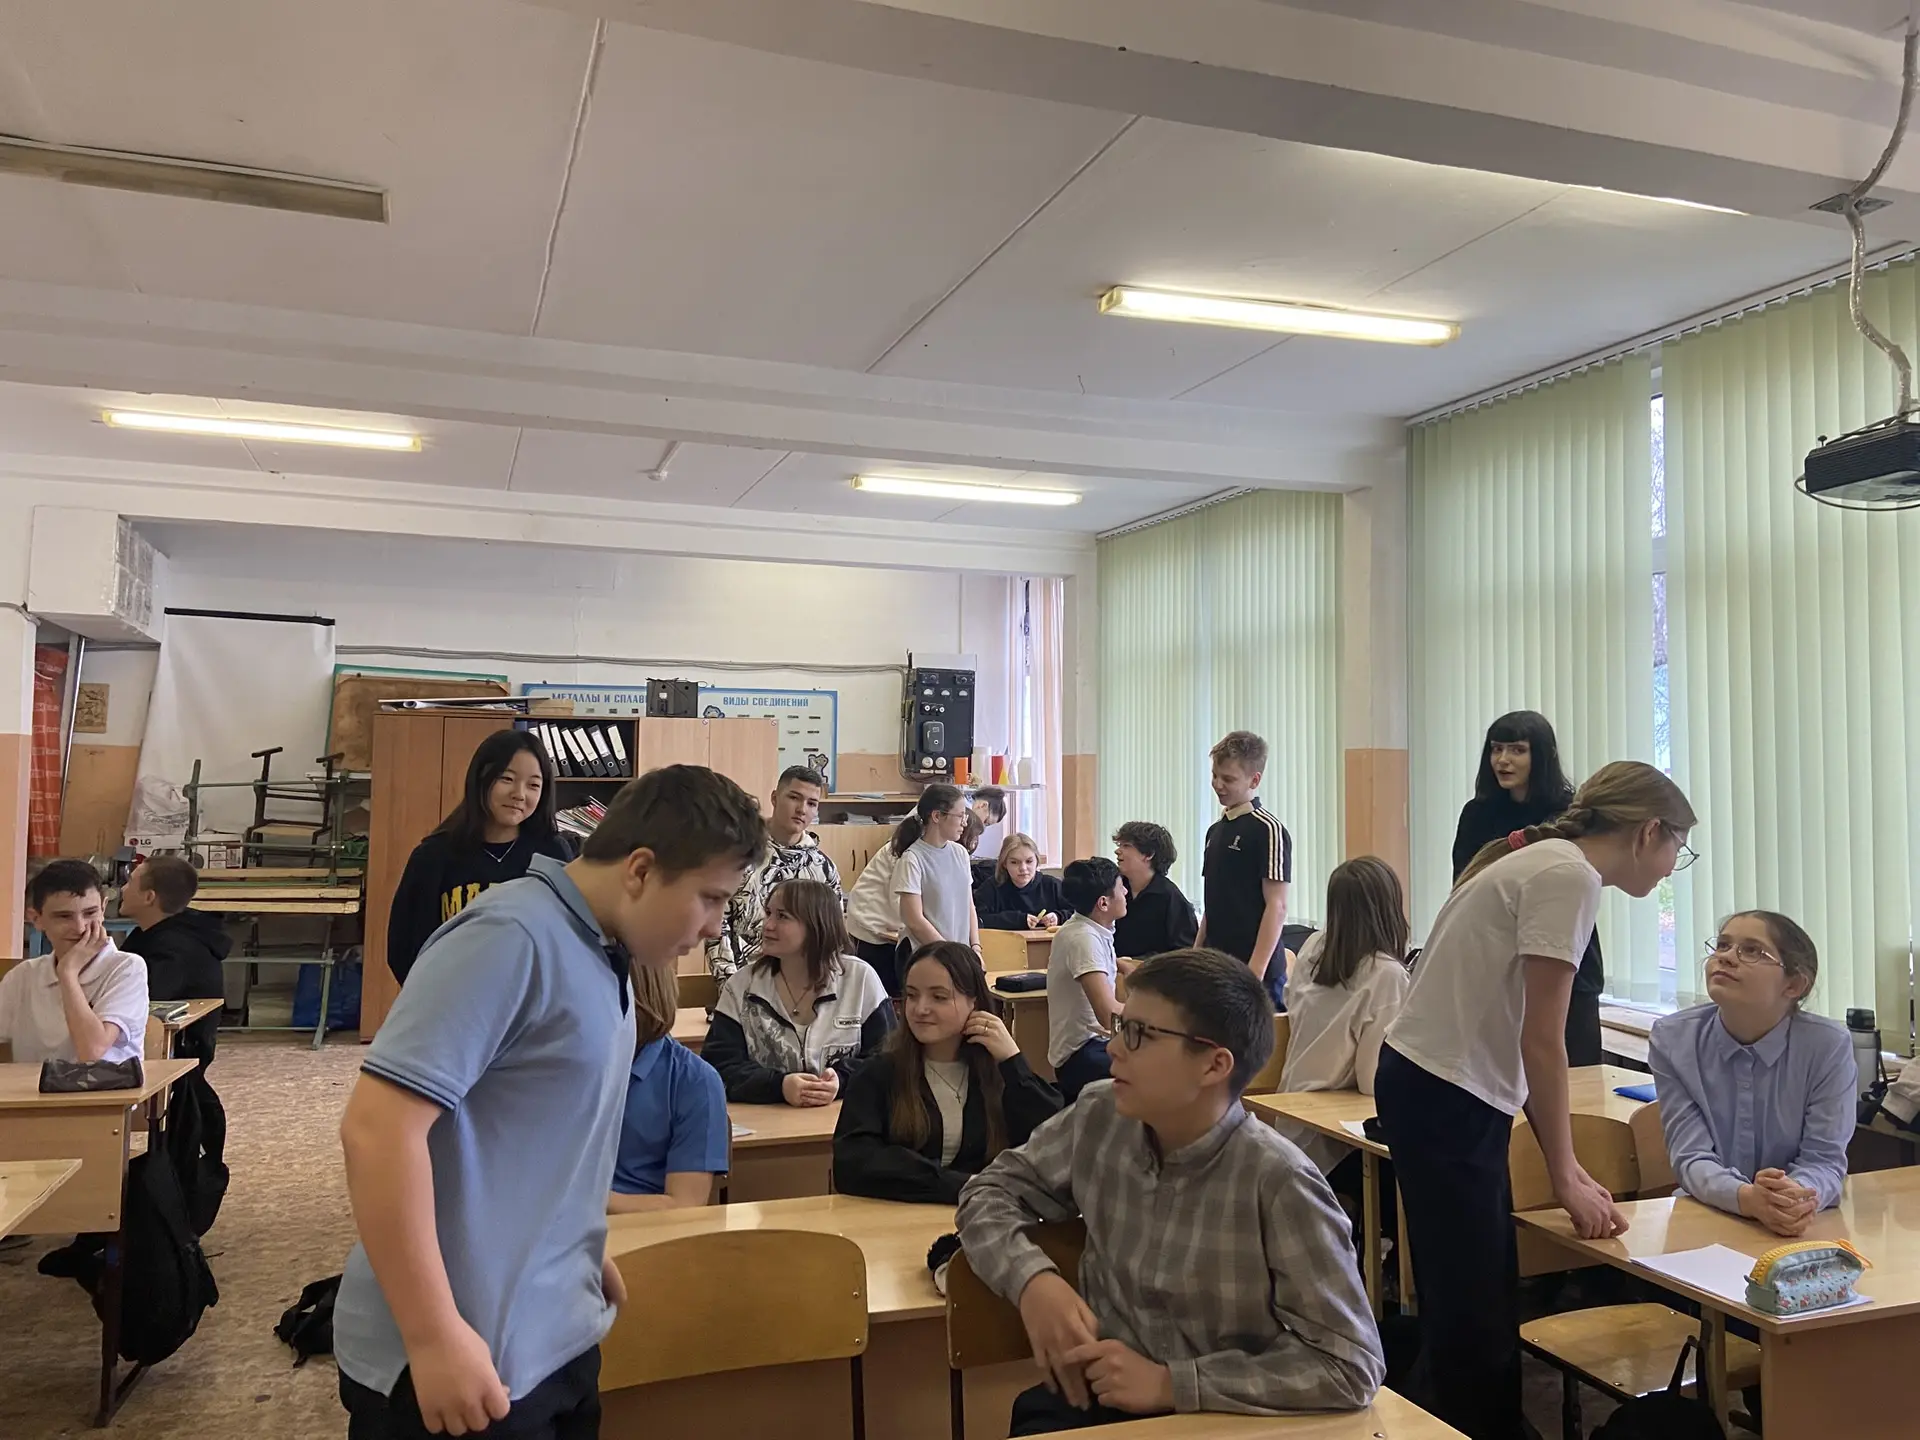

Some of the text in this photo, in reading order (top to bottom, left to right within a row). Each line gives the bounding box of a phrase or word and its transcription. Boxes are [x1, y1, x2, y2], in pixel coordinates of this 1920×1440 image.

[552, 693, 646, 704] МЕТАЛЛЫ И СПЛАВ
[723, 696, 809, 707] ВИДЫ СОЕДИНЕНИЙ
[140, 838, 152, 846] LG
